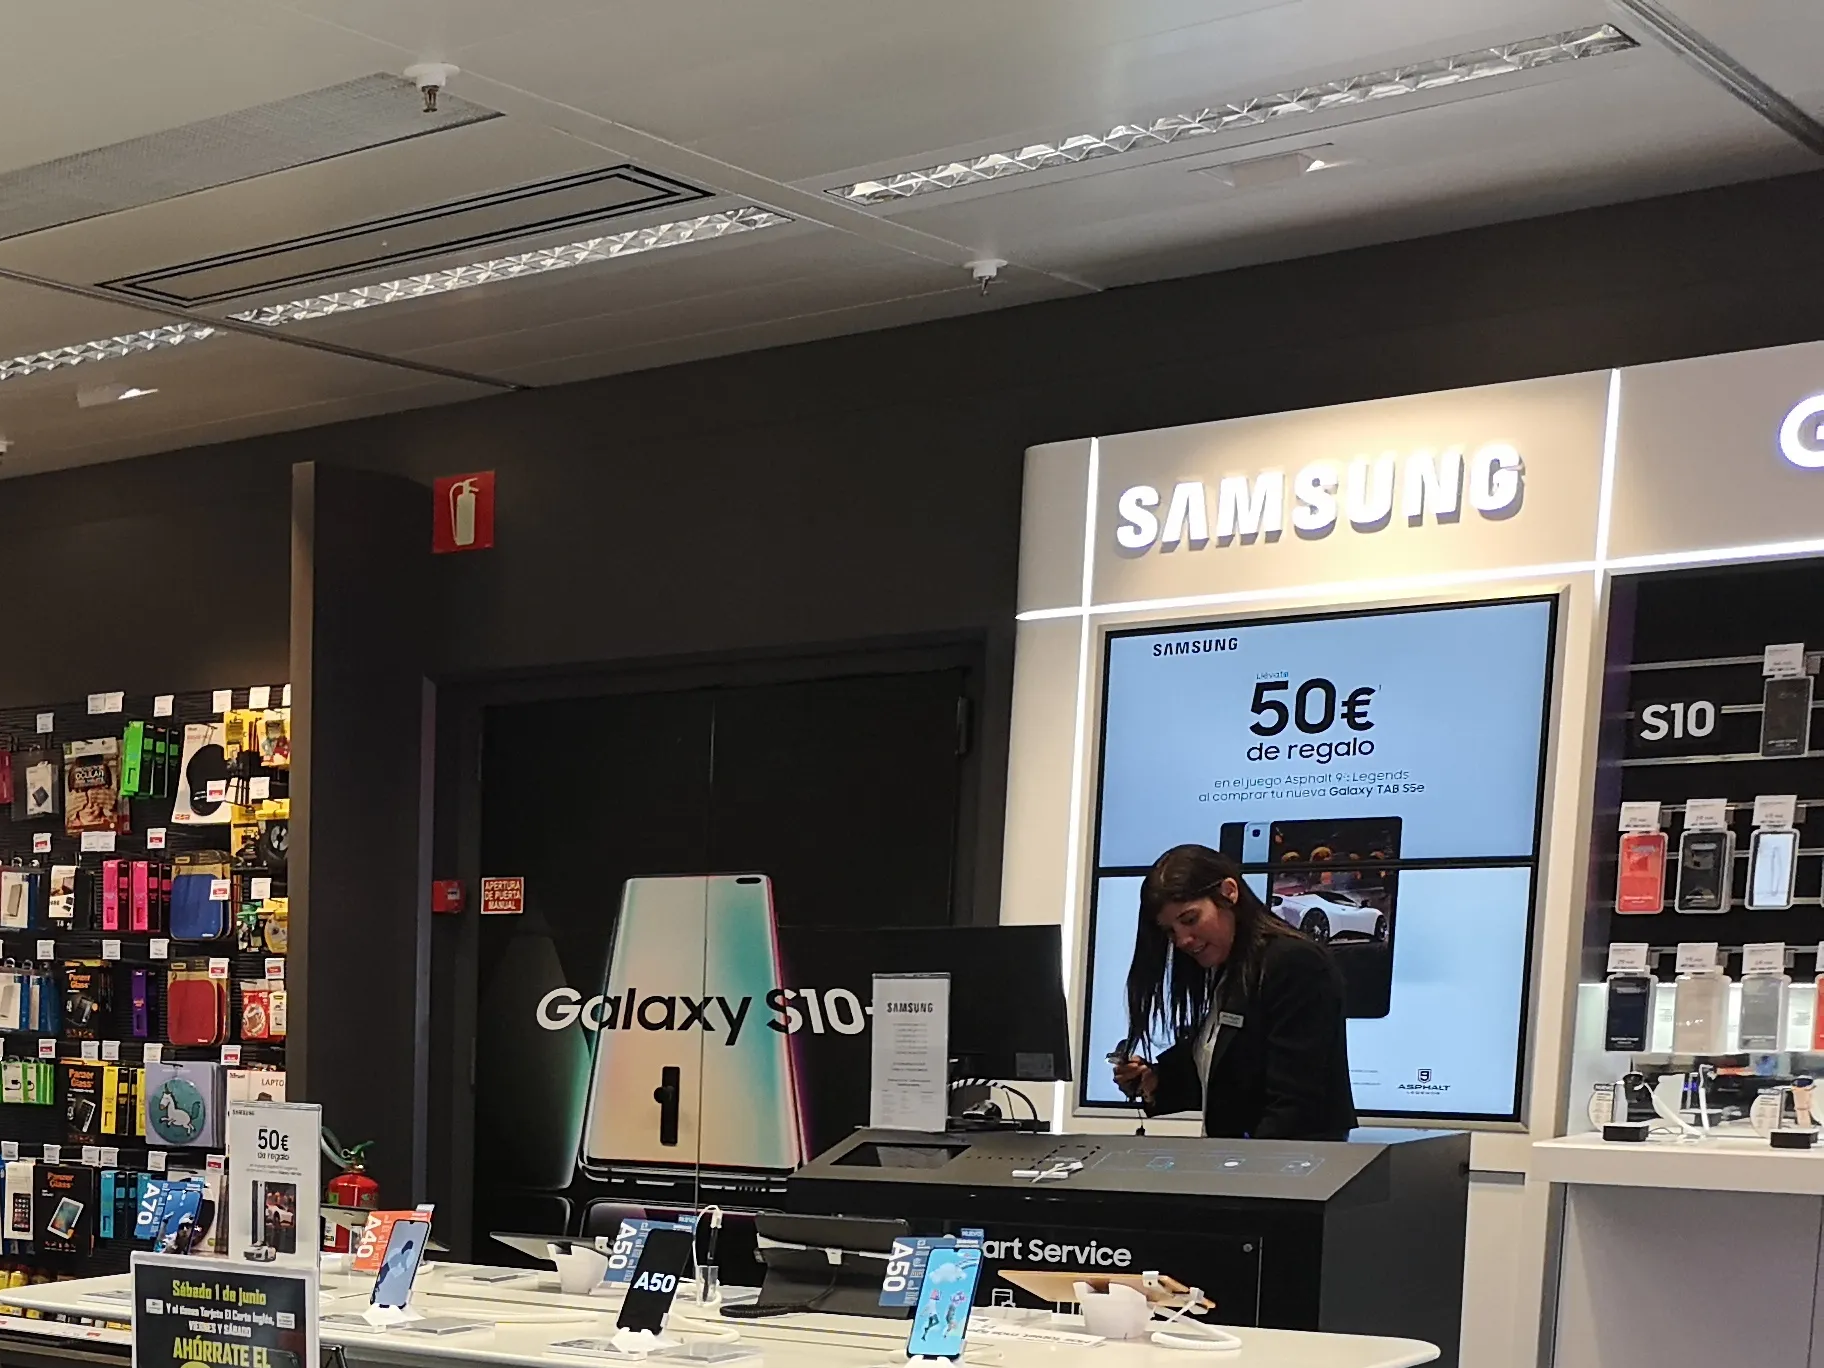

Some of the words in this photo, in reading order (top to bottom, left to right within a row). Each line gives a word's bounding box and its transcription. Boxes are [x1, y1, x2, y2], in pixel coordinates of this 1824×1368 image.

[1116, 443, 1526, 550] SAMSUNG
[1153, 637, 1238, 657] SAMSUNG
[1640, 701, 1716, 741] S10
[1246, 742, 1280, 761] de
[1287, 737, 1375, 765] regalo
[1214, 779, 1231, 788] en
[1232, 777, 1244, 787] el
[1244, 776, 1282, 790] juego
[1284, 772, 1332, 787] Asphalt
[1352, 769, 1410, 785] Legends
[1198, 792, 1210, 802] al
[1212, 789, 1268, 803] comprar
[1270, 789, 1284, 799] tu
[1285, 787, 1326, 798] nueva
[1328, 784, 1374, 800] Galaxy
[1377, 784, 1400, 795] TAB
[1402, 782, 1425, 793] S5e
[485, 881, 521, 890] APERTURA
[485, 891, 494, 900] DE
[495, 891, 521, 900] PUERTA
[488, 901, 516, 910] MANUAL
[536, 987, 753, 1046] Galaxy
[887, 1003, 933, 1013] SAMSUNG
[68, 1068, 95, 1080] Panzer
[71, 1078, 95, 1089] Glass
[1419, 1070, 1430, 1082] 9
[257, 1128, 289, 1152] 50€
[47, 1172, 75, 1182] Panzer
[49, 1180, 74, 1189] Glass
[137, 1182, 161, 1225] A70
[356, 1214, 382, 1258] A40
[608, 1221, 637, 1270] A50
[1028, 1238, 1132, 1267] Service
[882, 1240, 914, 1292] A50
[172, 1280, 212, 1300] Sábado
[215, 1284, 220, 1300] 1
[222, 1285, 236, 1301] de
[633, 1271, 677, 1293] A50
[173, 1335, 250, 1368] AHÓRRATE
